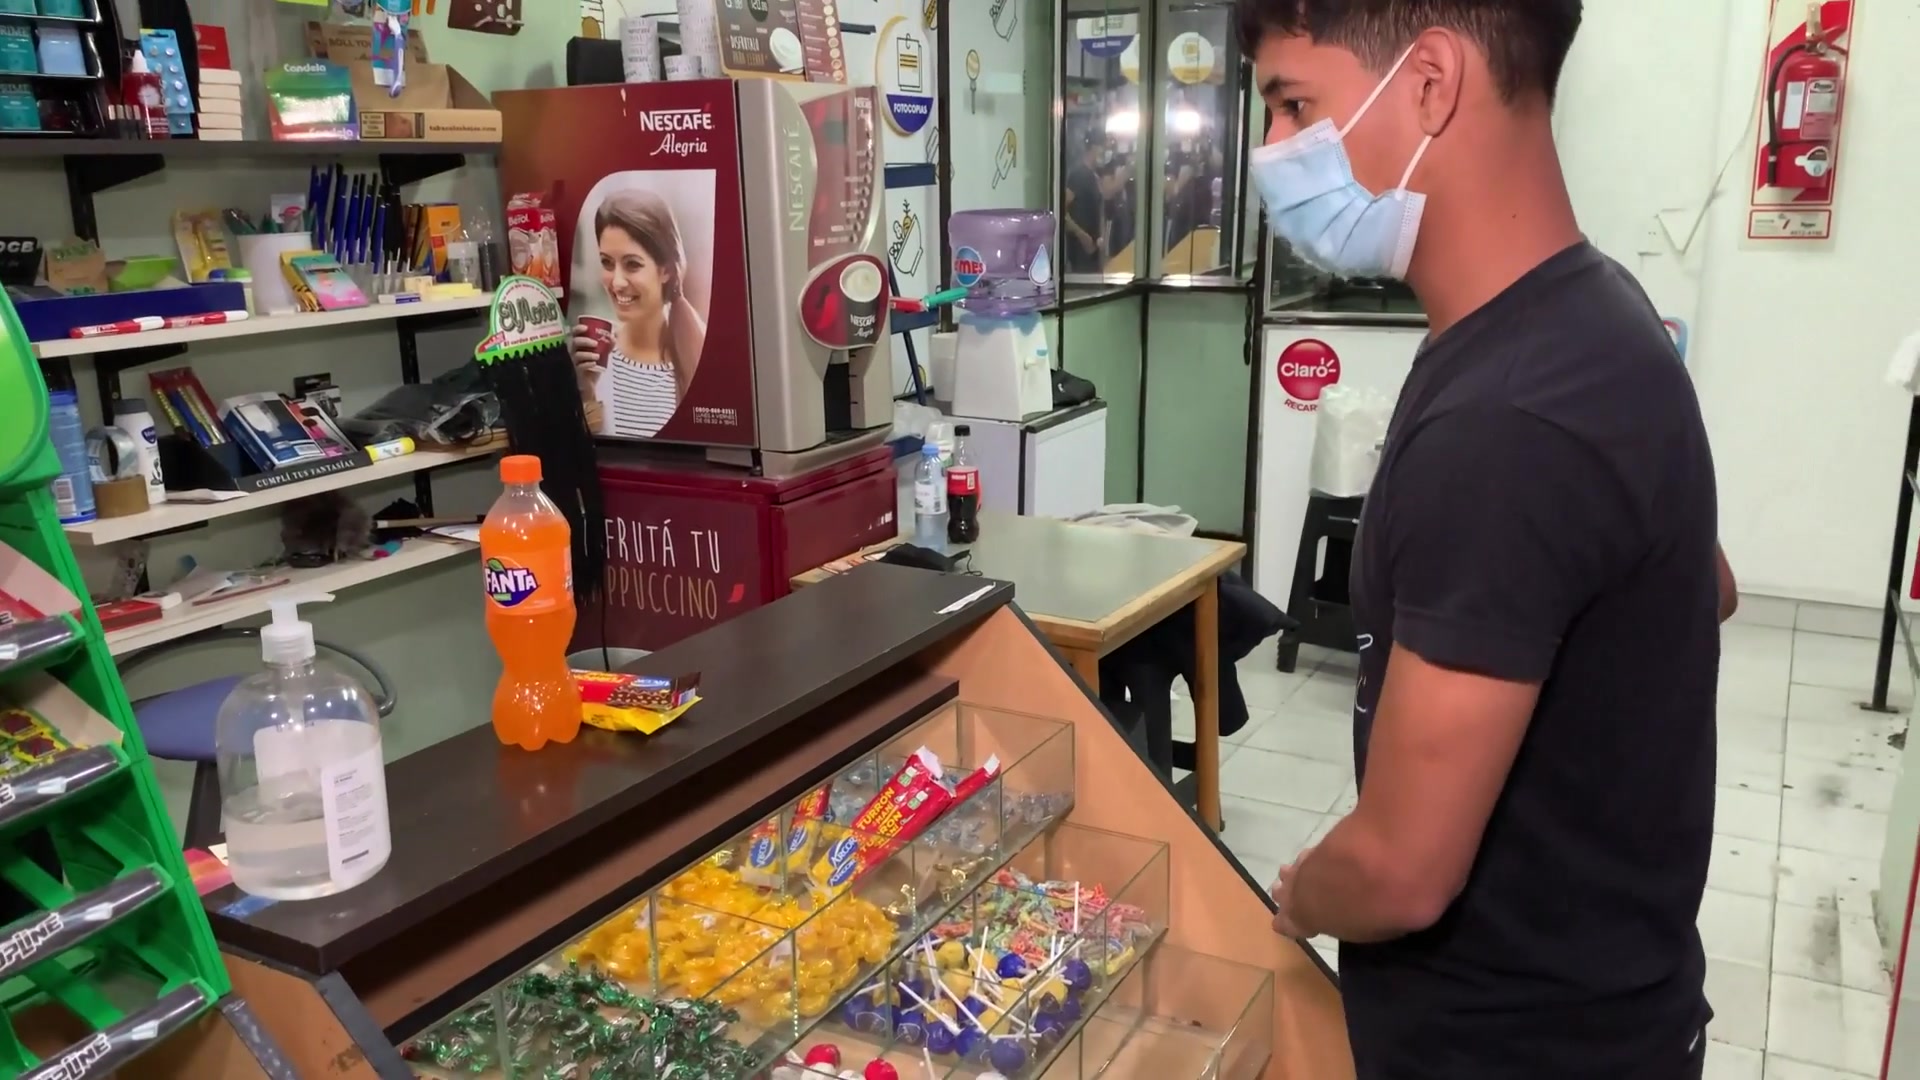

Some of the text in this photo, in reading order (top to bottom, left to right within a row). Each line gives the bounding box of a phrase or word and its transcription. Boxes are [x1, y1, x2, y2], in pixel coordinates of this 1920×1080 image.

[283, 63, 327, 73] Candela
[893, 102, 928, 114] FOTOCOPIAS
[649, 132, 708, 157] Alegria
[1280, 357, 1328, 378] Claro
[256, 459, 355, 488] CUMPLÍ TUS FANTASÍAS
[604, 516, 720, 574] FRUTÁ TU
[607, 565, 718, 620] PPUCCINO
[830, 837, 858, 869] ARCOR
